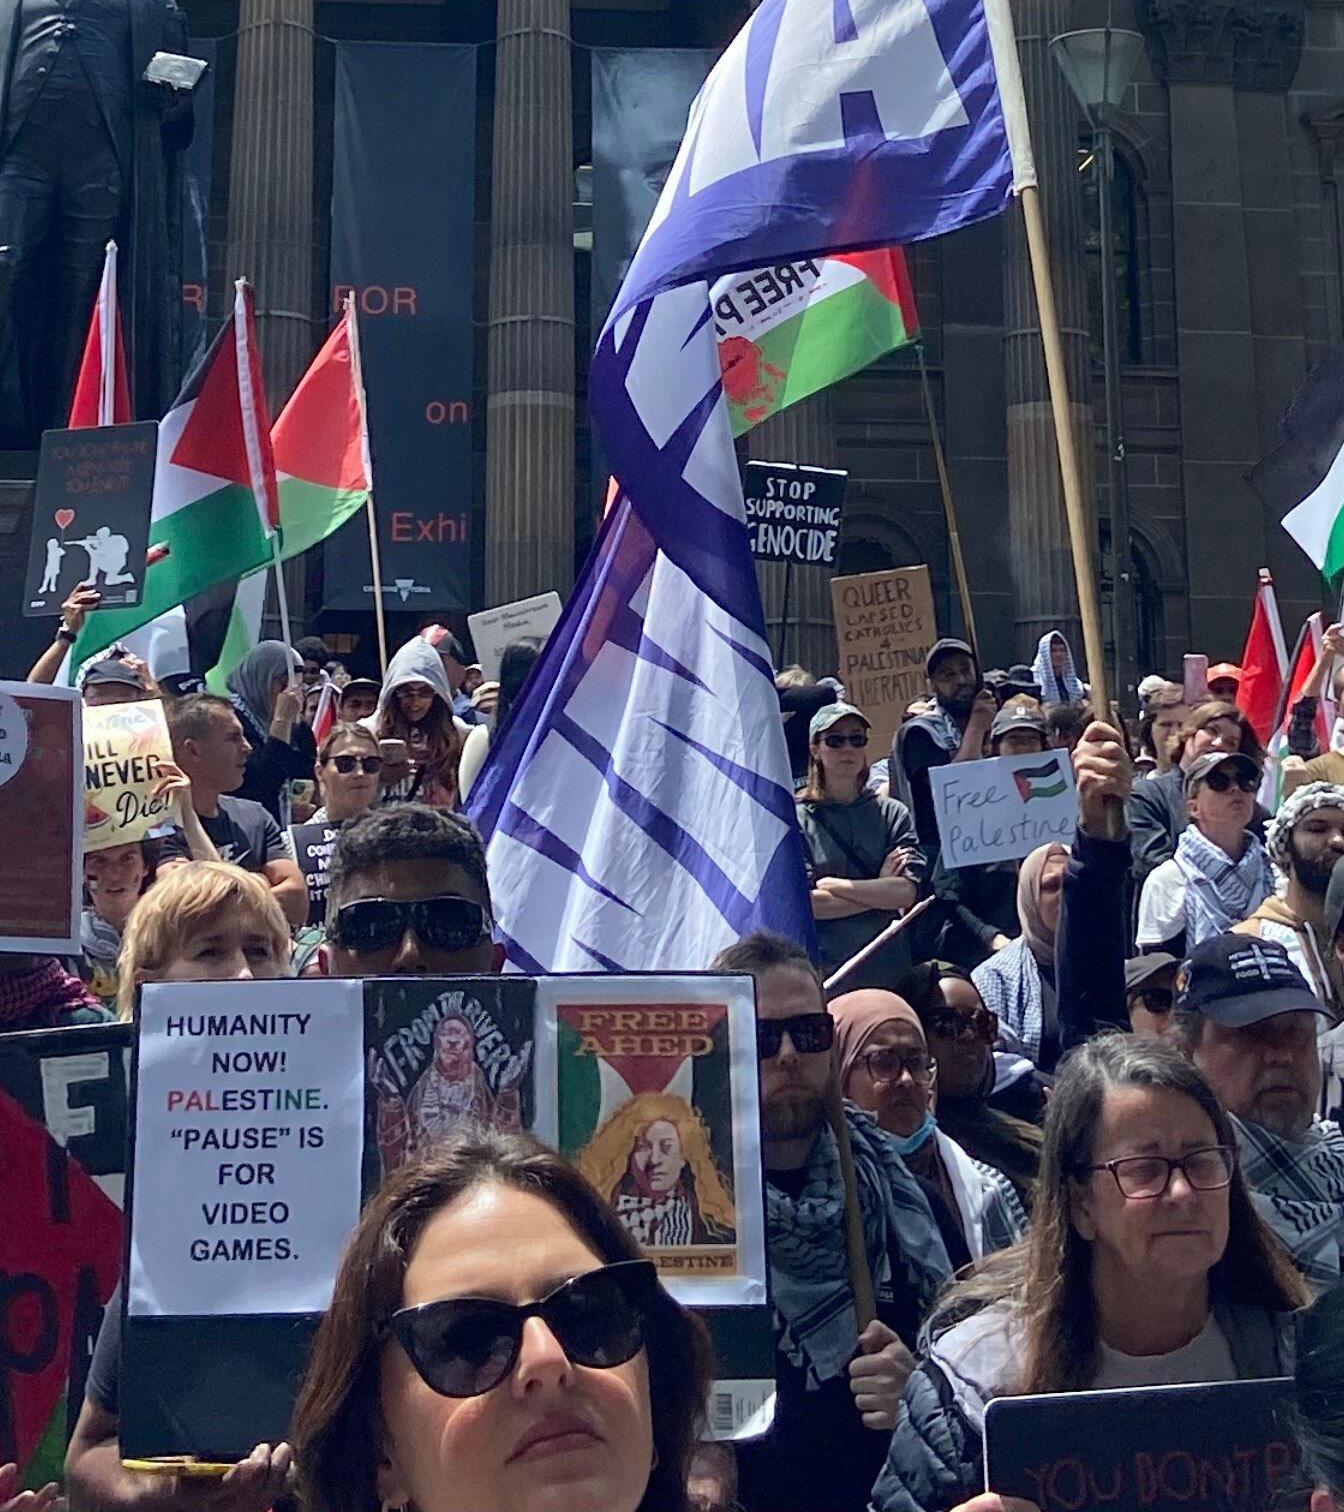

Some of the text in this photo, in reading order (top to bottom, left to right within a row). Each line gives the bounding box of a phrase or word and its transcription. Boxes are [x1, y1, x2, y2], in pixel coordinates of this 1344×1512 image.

[425, 402, 468, 424] on
[766, 478, 816, 501] STOP
[745, 498, 841, 528] SUPPORTING
[391, 512, 467, 543] Exhi
[842, 577, 913, 608] QUEER
[845, 603, 914, 626] LAPSED
[845, 617, 923, 643] CATHOLICS
[87, 739, 119, 761] ILL
[84, 753, 165, 791] NEVER
[942, 779, 1009, 816] Free
[949, 813, 1076, 864] Palestine
[167, 1013, 312, 1037] HUMANITY
[579, 1009, 709, 1032] FREE
[384, 1003, 441, 1088] FROM
[464, 996, 512, 1089] RIVER
[573, 1035, 714, 1057] AHED
[212, 1050, 287, 1074] NOW!
[167, 1088, 329, 1113] PALESTINE.
[299, 1126, 325, 1149] IS
[218, 1163, 275, 1185] FOR
[202, 1201, 290, 1226] VIDEO
[190, 1238, 300, 1263] GAMES.
[656, 1254, 735, 1269] LESTINE
